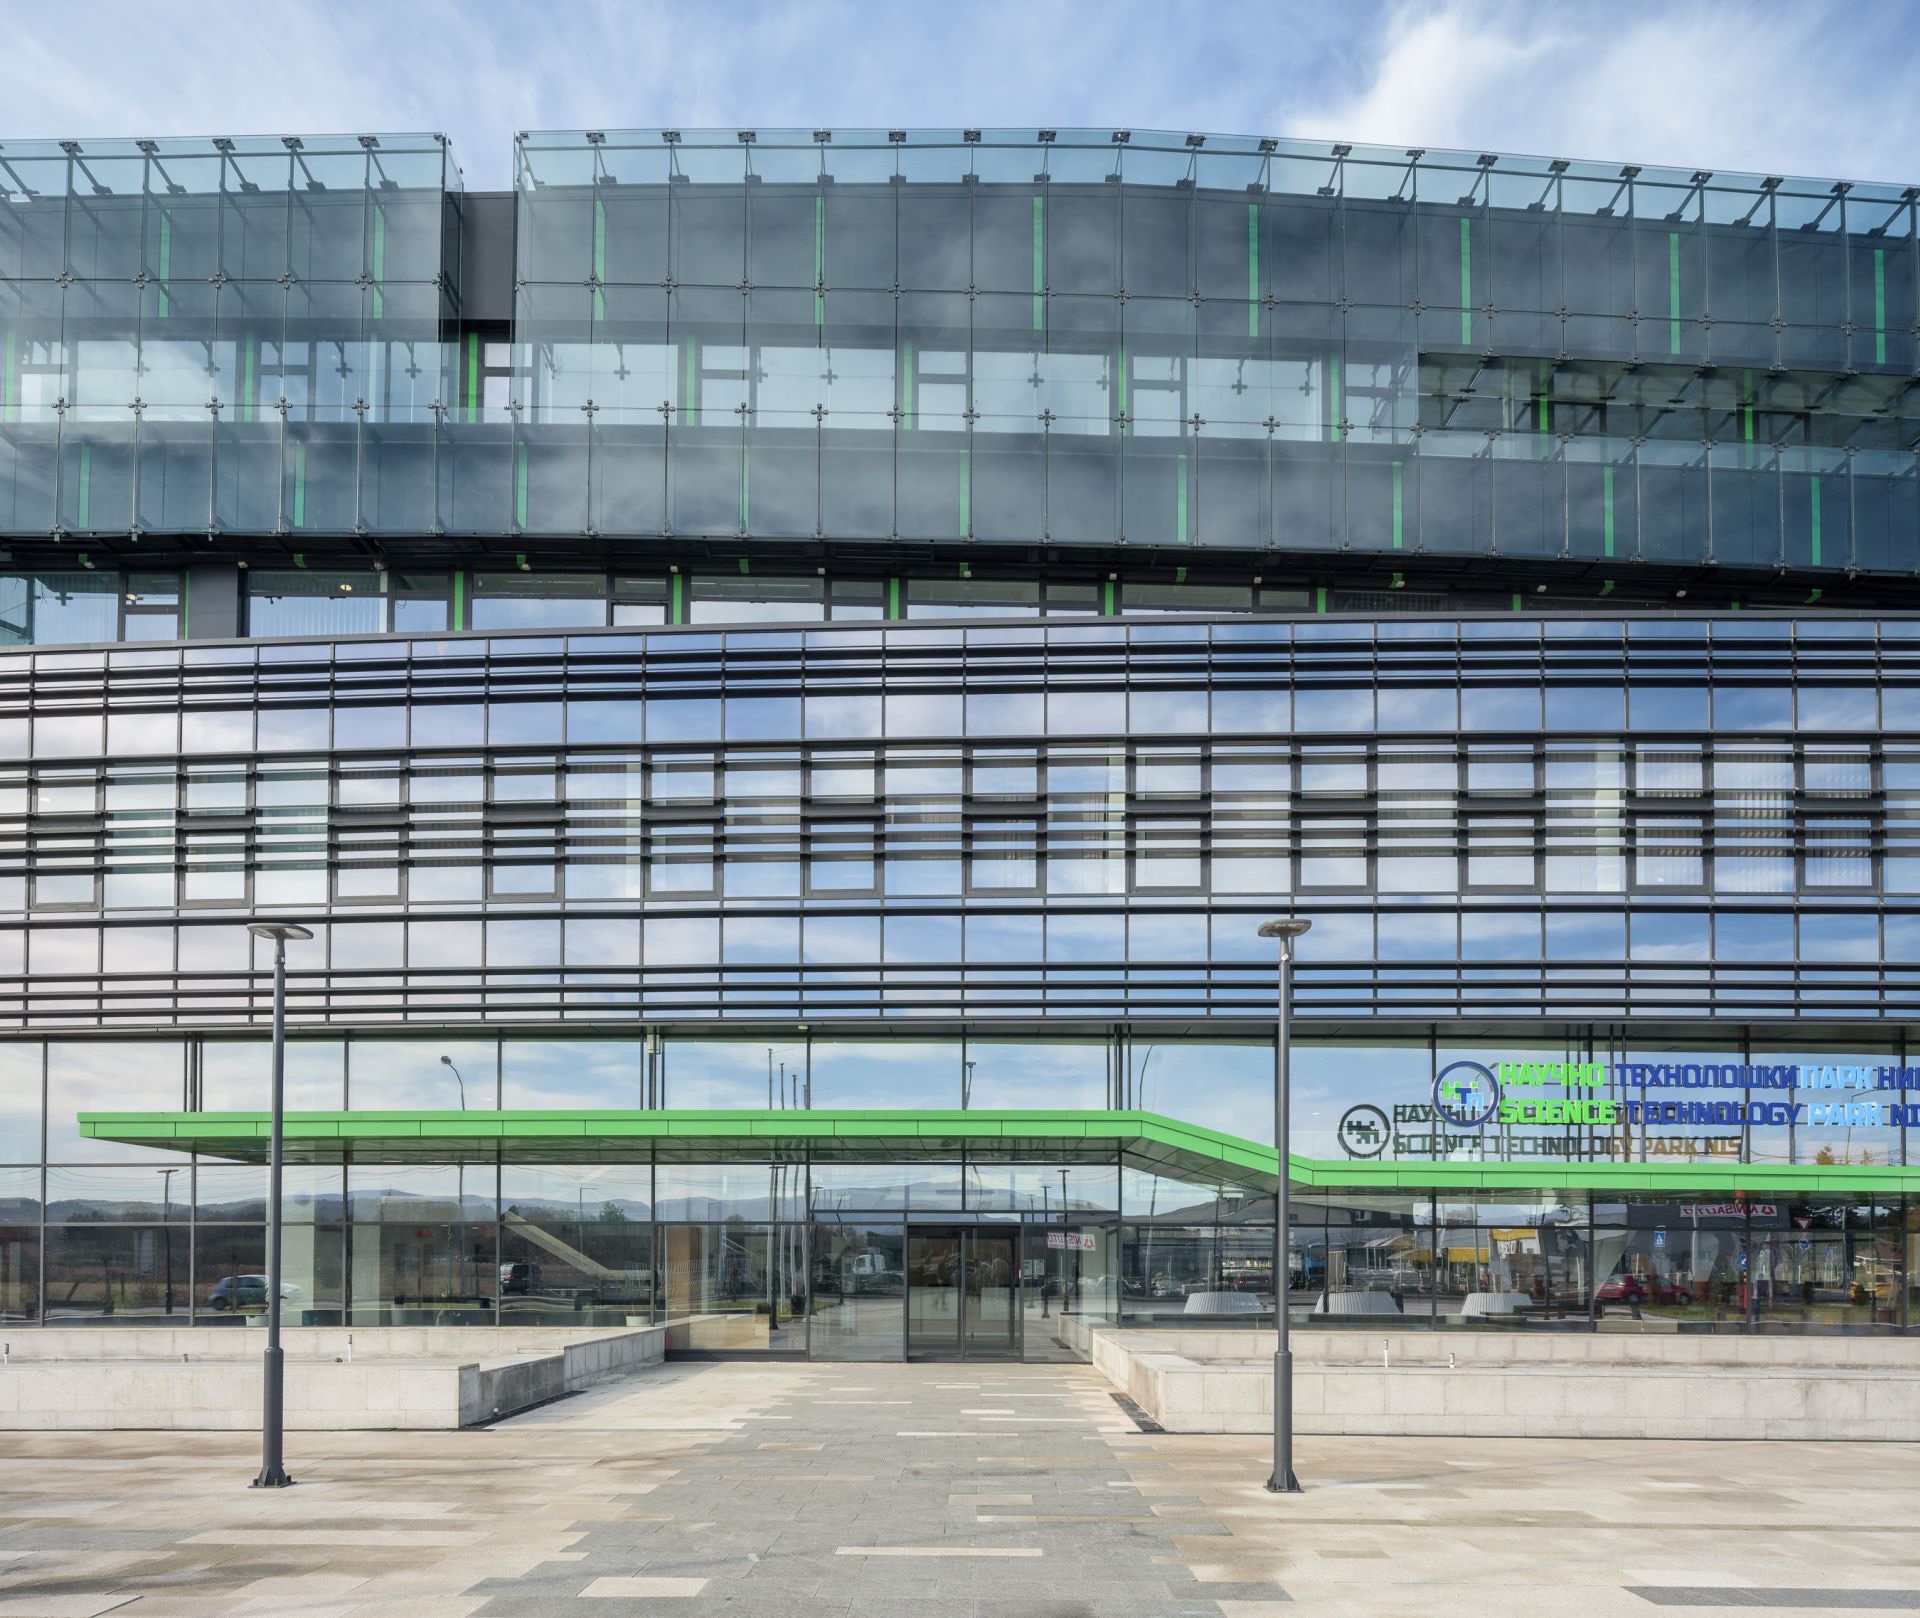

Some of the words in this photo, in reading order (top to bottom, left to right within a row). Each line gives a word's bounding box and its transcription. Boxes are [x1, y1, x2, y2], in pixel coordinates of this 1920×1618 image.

[1499, 1062, 1605, 1087] НАУЧНО
[1615, 1063, 1797, 1089] ТЕХНОЛОШКИ
[1800, 1065, 1873, 1089] ПАРК
[1499, 1099, 1616, 1124] SCIENCE
[1624, 1100, 1802, 1127] TECHNOLOGY
[1807, 1103, 1883, 1127] PARK
[1641, 1136, 1698, 1155] PARK
[1704, 1136, 1742, 1155] NIS
